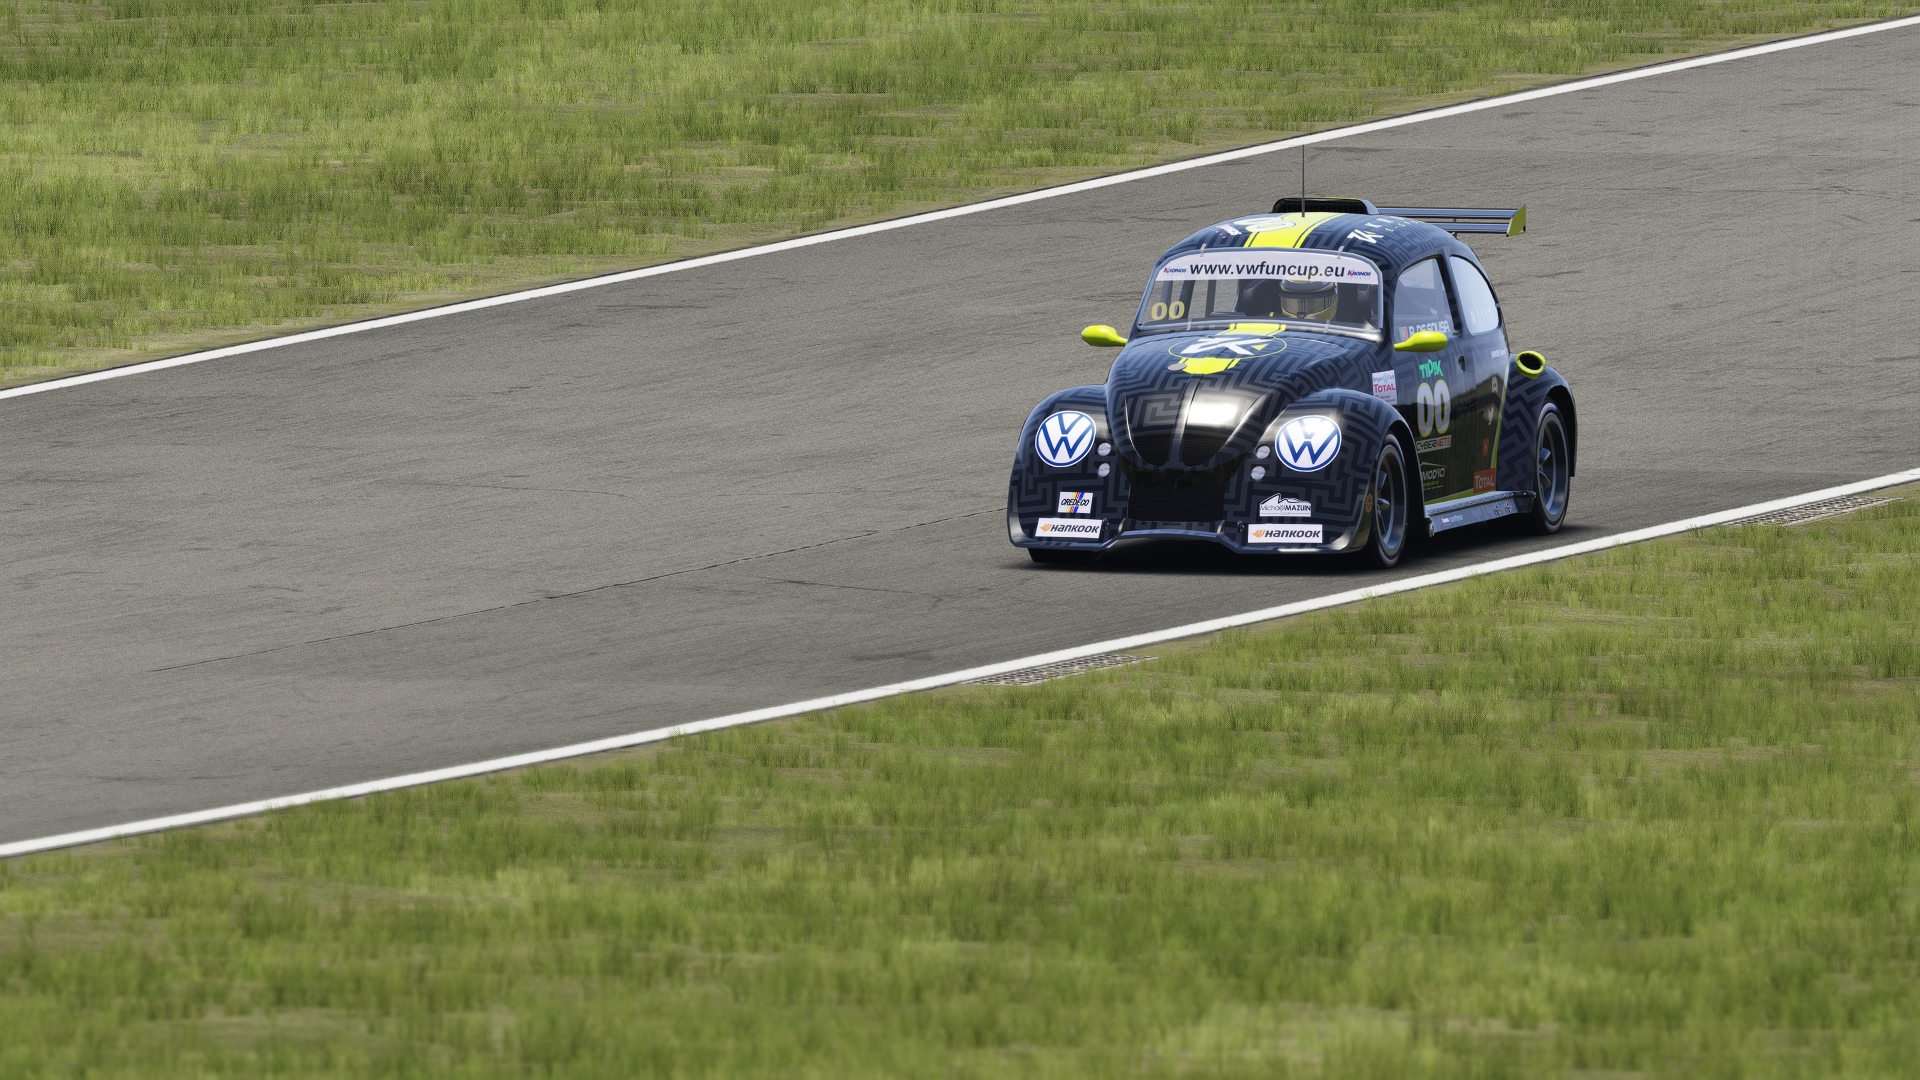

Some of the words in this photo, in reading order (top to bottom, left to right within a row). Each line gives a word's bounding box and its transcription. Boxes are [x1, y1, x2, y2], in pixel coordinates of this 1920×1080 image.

[1190, 261, 1345, 279] www.vwfuncup.eu
[1151, 301, 1185, 320] 00
[1373, 383, 1397, 393] TOTAL
[1417, 380, 1450, 437] 00
[1038, 412, 1095, 464] VW
[1474, 475, 1495, 490] TOTAL
